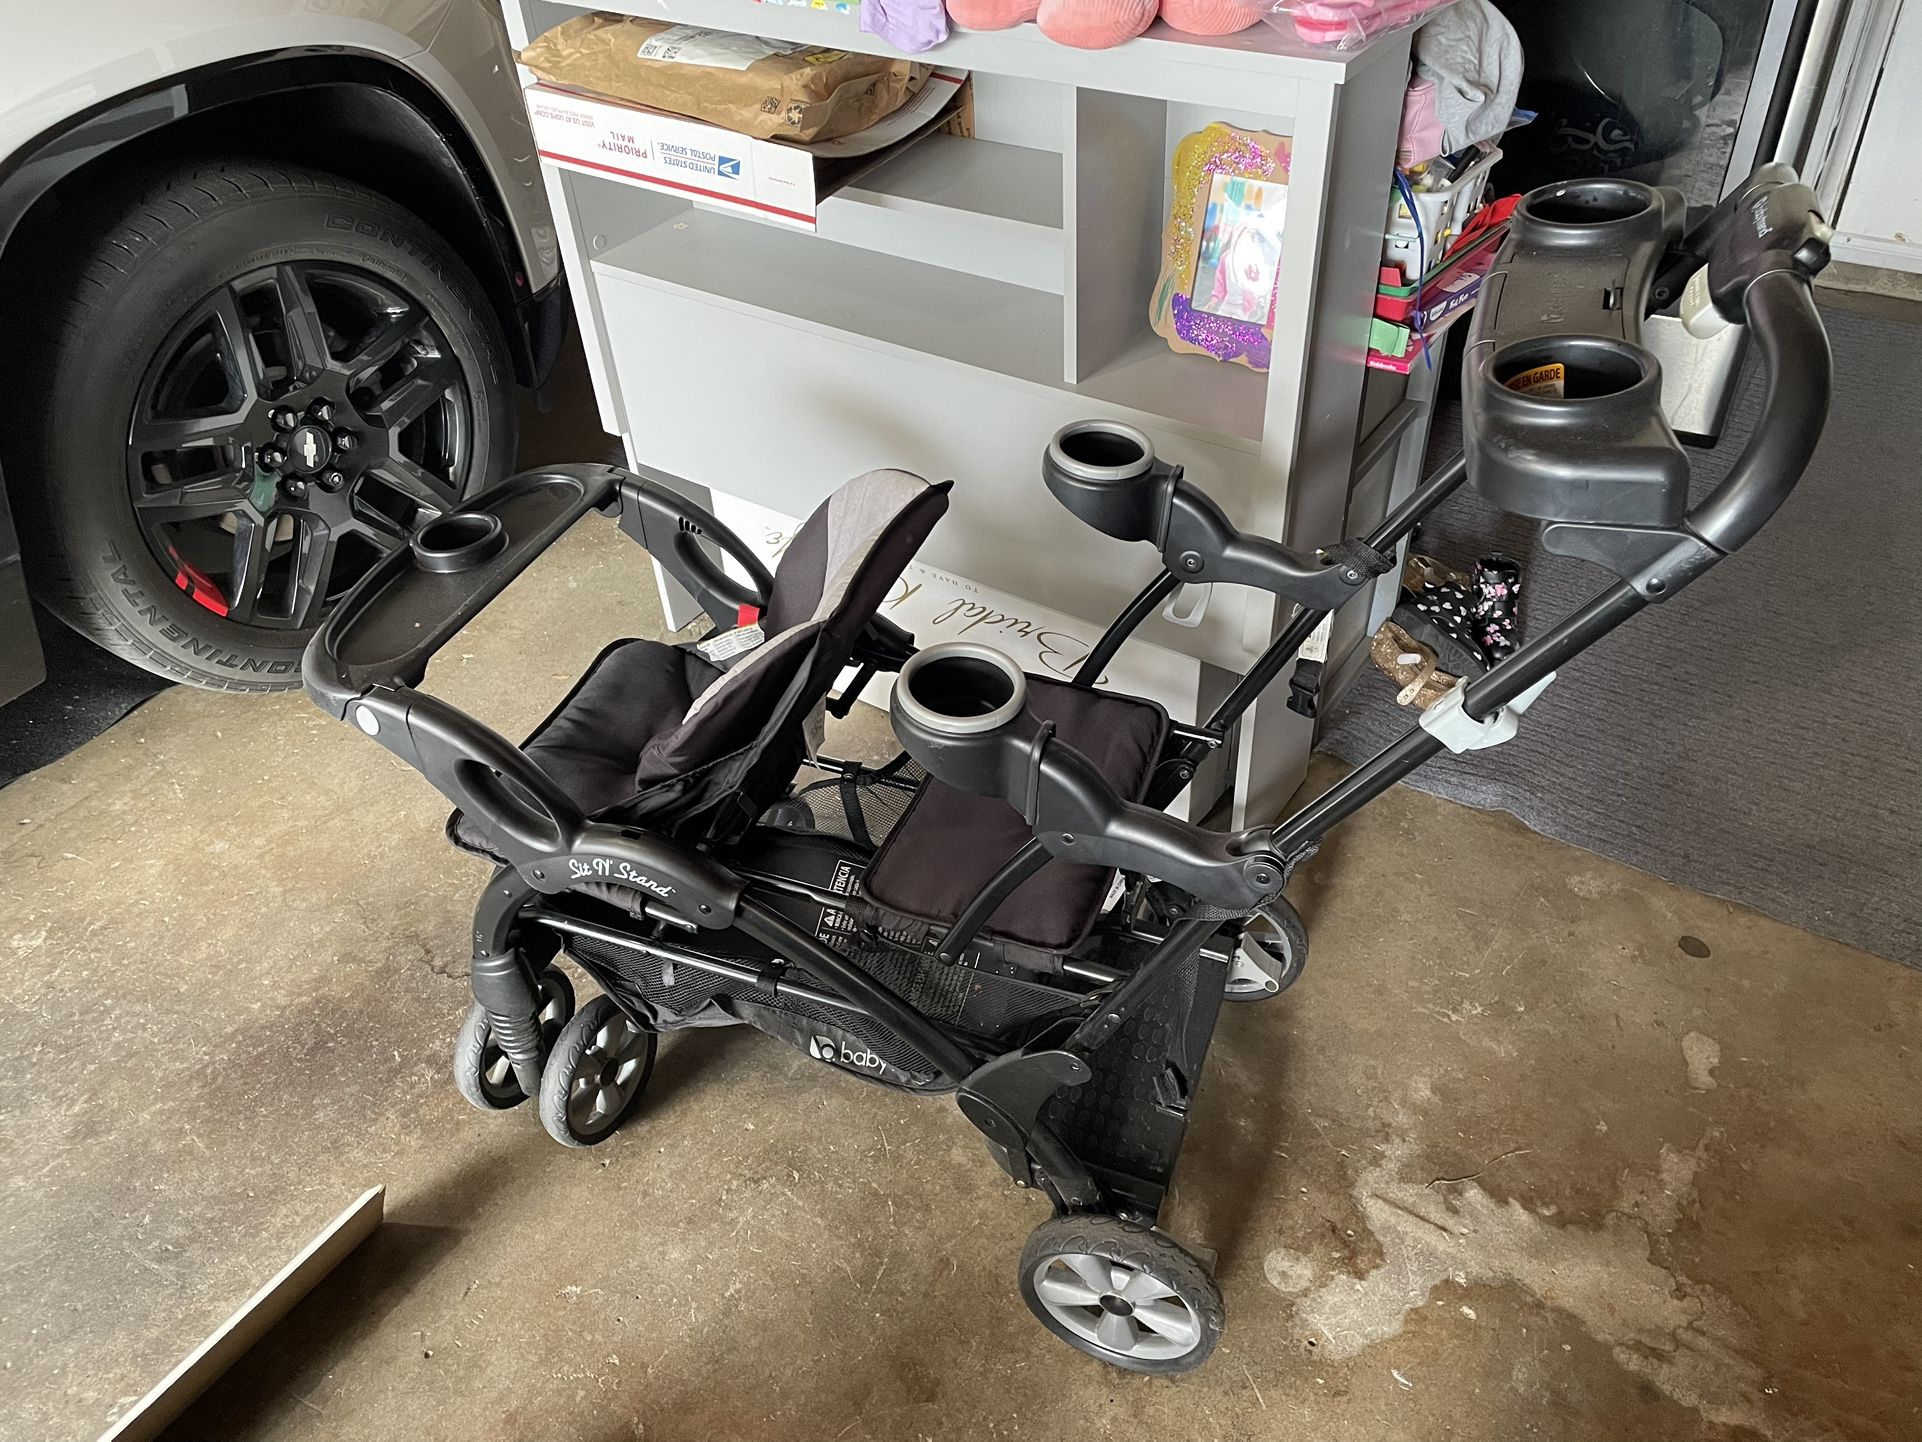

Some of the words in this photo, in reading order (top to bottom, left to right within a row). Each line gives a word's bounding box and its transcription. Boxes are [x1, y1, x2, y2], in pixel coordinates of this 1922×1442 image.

[609, 131, 635, 144] MAIL
[689, 148, 716, 162] POSTAL
[663, 156, 688, 169] STATES
[688, 162, 716, 175] UNITED
[1532, 368, 1561, 383] GARDE
[932, 573, 958, 588] HAVE
[963, 584, 979, 594] TO
[102, 541, 303, 676] ONTINENTAL
[932, 598, 1108, 685] Bridal
[568, 859, 593, 879] Sit
[613, 862, 673, 897] Stand
